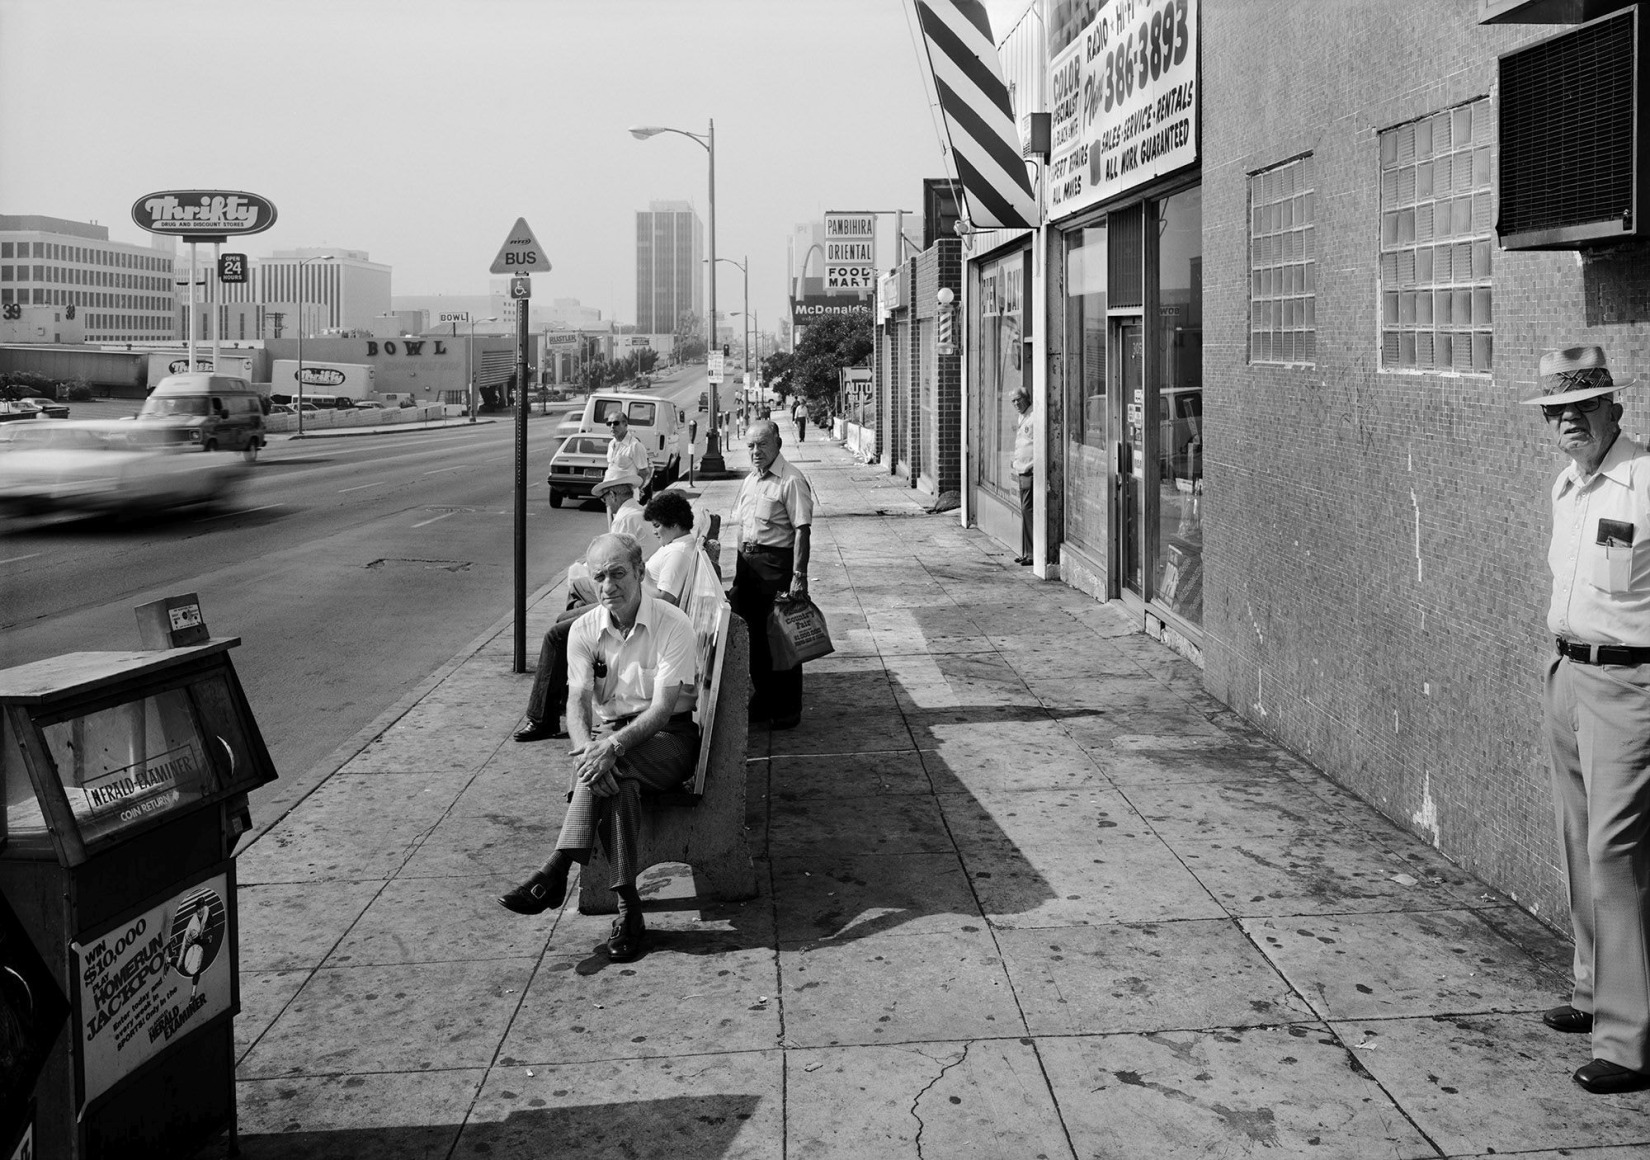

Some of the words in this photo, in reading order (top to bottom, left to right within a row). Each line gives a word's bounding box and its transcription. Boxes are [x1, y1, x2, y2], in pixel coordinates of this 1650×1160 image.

[1087, 17, 1109, 63] RADIO
[1105, 0, 1188, 113] 386-3893
[1053, 54, 1080, 106] COLOR
[1106, 156, 1119, 182] ALL
[1121, 144, 1139, 175] WORK
[1141, 117, 1190, 165] GUARANTEED
[1053, 186, 1062, 206] ALL
[1063, 175, 1082, 202] MAKES
[145, 196, 258, 229] Thrifty
[827, 219, 873, 235] PAMBIHIRA
[505, 252, 537, 265] BUS
[828, 244, 871, 260] ORIENTAL
[224, 261, 242, 275] 24
[829, 267, 870, 277] FOOD
[829, 277, 870, 287] MART
[2, 303, 22, 320] 39
[440, 312, 467, 322] BOWL
[795, 304, 868, 315] McDonald's
[366, 341, 447, 356] BOWL
[845, 382, 872, 394] AUTO
[91, 756, 192, 807] HERALD-EXAMINER
[120, 807, 142, 821] COIN
[142, 794, 170, 812] RETURN
[84, 918, 146, 988] $10,000
[85, 940, 107, 966] WIN
[87, 936, 178, 1041] JACKPOT
[92, 972, 109, 994] PLAY
[112, 1011, 130, 1032] Enter
[132, 991, 149, 1012] today
[151, 977, 162, 992] and
[115, 1019, 134, 1040] every
[134, 1001, 152, 1020] week
[153, 993, 160, 1002] in
[117, 1020, 146, 1051] SPORTS!
[145, 1004, 160, 1021] Only
[160, 998, 167, 1006] in
[166, 986, 178, 999] the
[164, 993, 207, 1041] EXAMINER
[148, 1005, 180, 1044] HERALD
